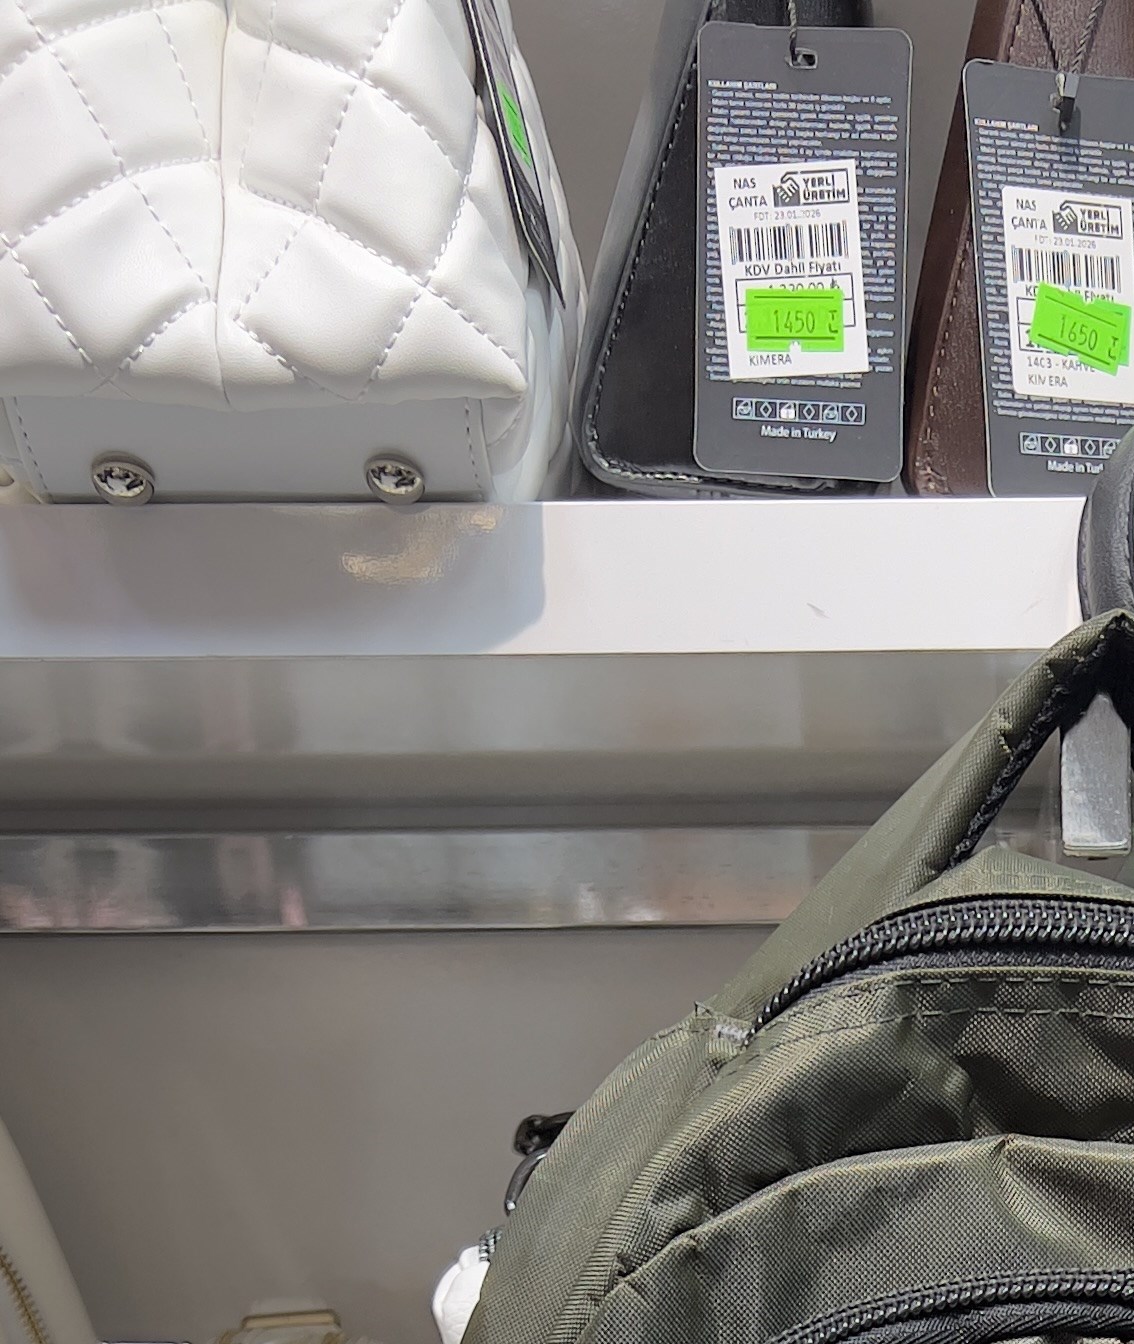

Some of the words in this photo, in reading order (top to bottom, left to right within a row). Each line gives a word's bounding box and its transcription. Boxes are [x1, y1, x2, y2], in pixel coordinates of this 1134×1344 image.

[733, 178, 757, 190] NAS
[728, 195, 768, 210] ÇANTA
[1016, 199, 1037, 211] NAS
[1011, 216, 1047, 230] ÇANTA
[745, 264, 770, 277] KDV
[809, 260, 841, 274] Fiyatı
[773, 309, 816, 334] 1450
[1059, 314, 1099, 351] 1650
[761, 425, 789, 438] Made
[791, 427, 802, 438] in
[803, 428, 837, 442] Turkey
[1047, 460, 1074, 472] Made
[1075, 462, 1085, 473] in
